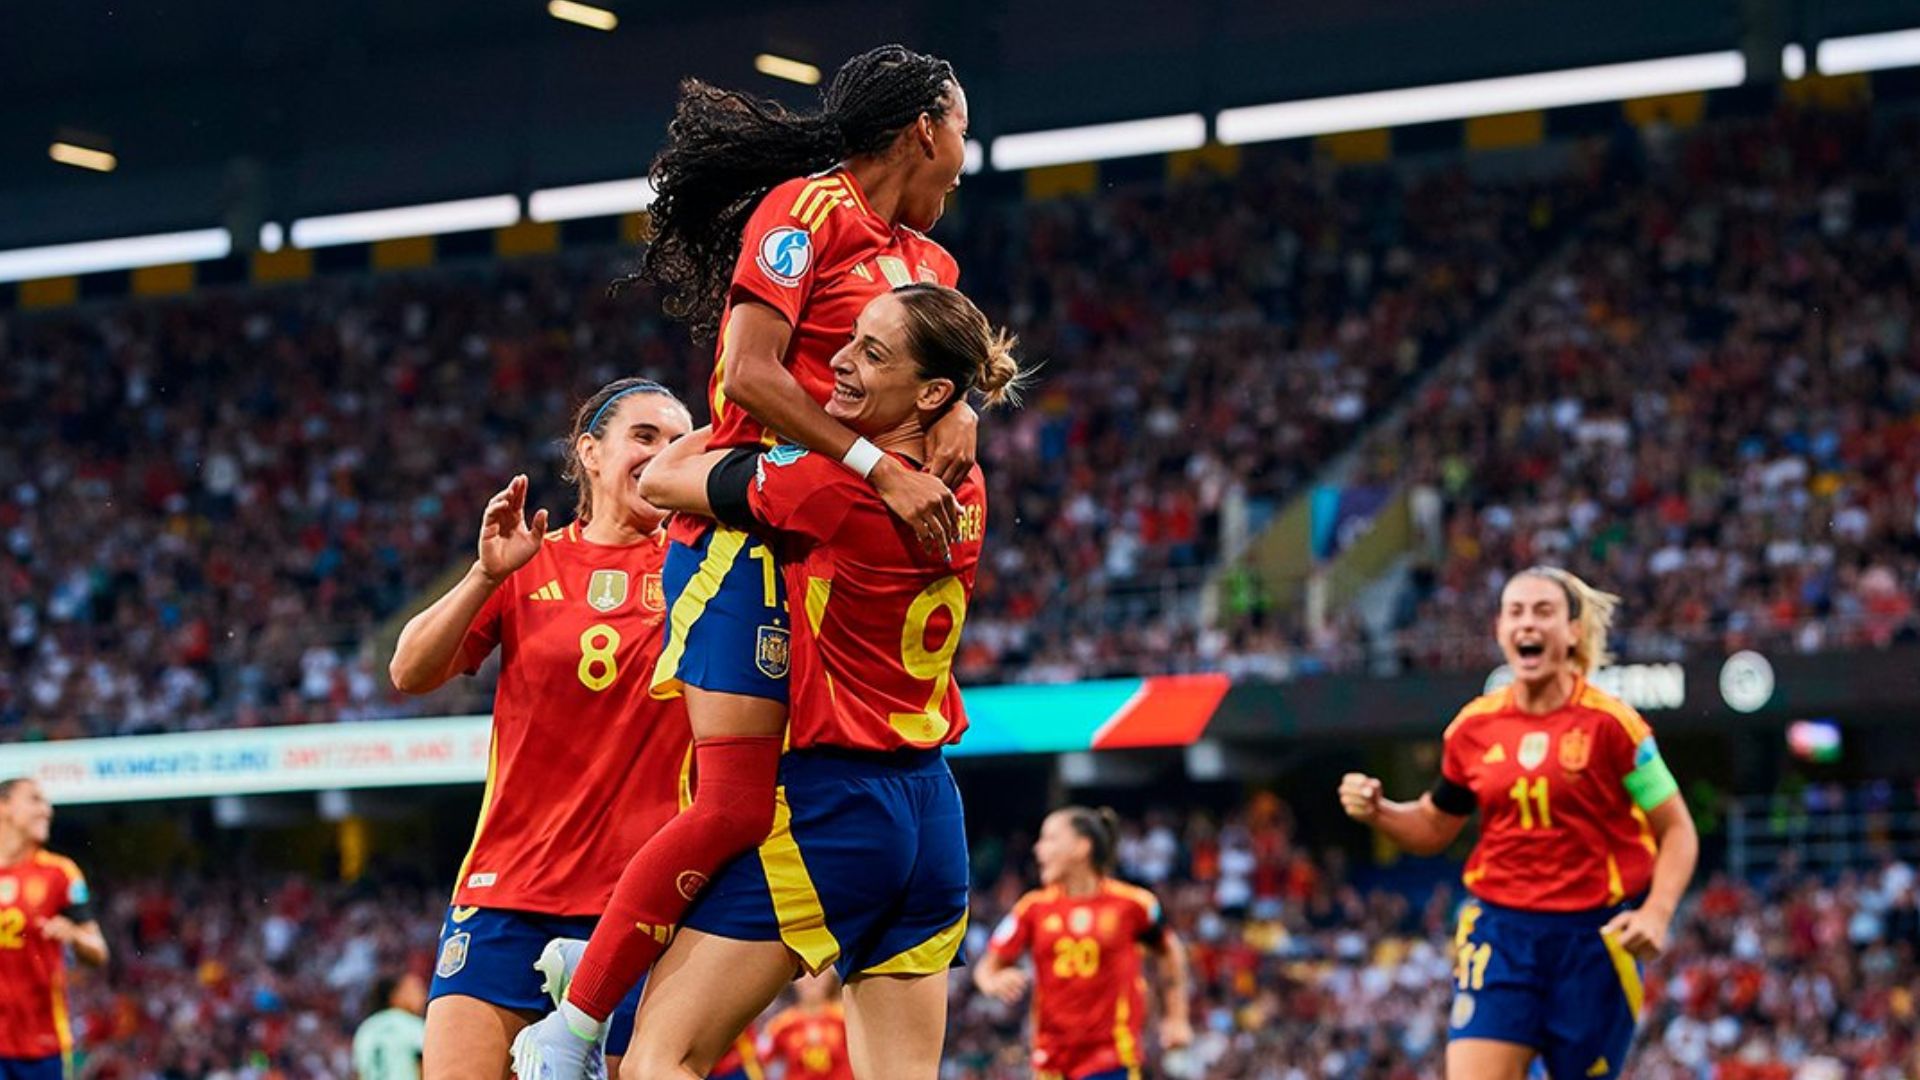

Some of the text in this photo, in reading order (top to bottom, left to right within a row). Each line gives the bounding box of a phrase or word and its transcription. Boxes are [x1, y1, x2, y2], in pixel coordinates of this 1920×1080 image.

[957, 504, 983, 542] HER
[750, 545, 789, 612] 1
[578, 624, 620, 691] 8
[889, 576, 966, 743] 9
[1509, 775, 1552, 830] 11
[1053, 937, 1099, 979] 20
[1457, 942, 1492, 990] 11
